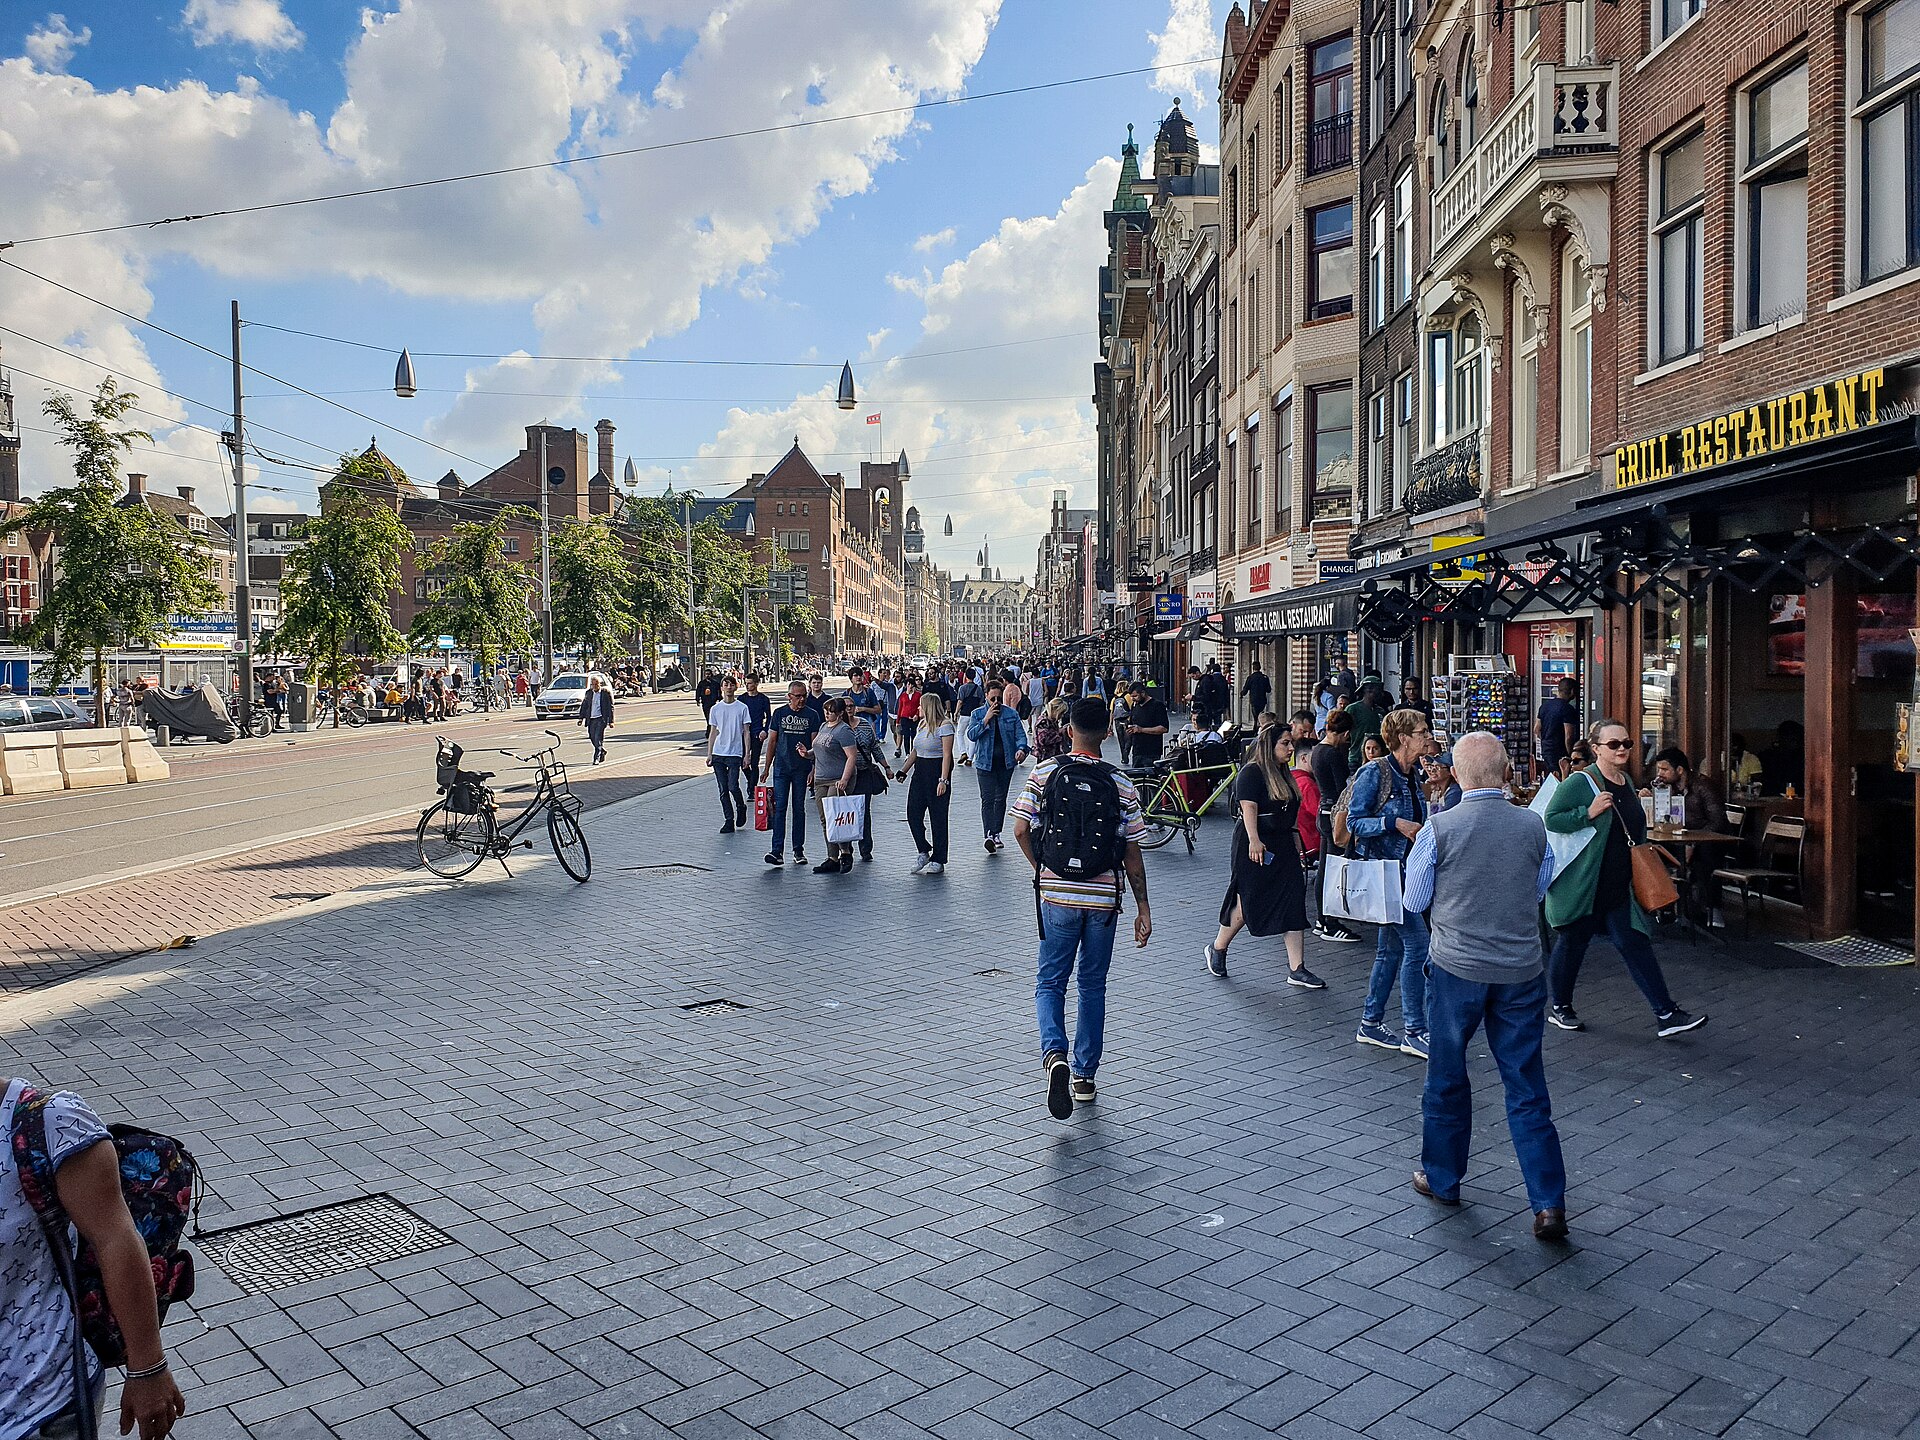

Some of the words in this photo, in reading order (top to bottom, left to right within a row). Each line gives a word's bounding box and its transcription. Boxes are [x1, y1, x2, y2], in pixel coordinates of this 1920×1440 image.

[1615, 434, 1673, 489] GRILL
[1681, 367, 1884, 473] RESTAURANT
[1321, 565, 1354, 574] CHANGE
[1195, 591, 1215, 599] ATM
[1234, 611, 1263, 633] BRASSERIE
[1263, 612, 1268, 632] &
[1268, 608, 1287, 631] GRILL
[1287, 602, 1335, 630] RESTAURANT
[205, 635, 224, 643] CRUISE
[834, 811, 855, 828] H&M
